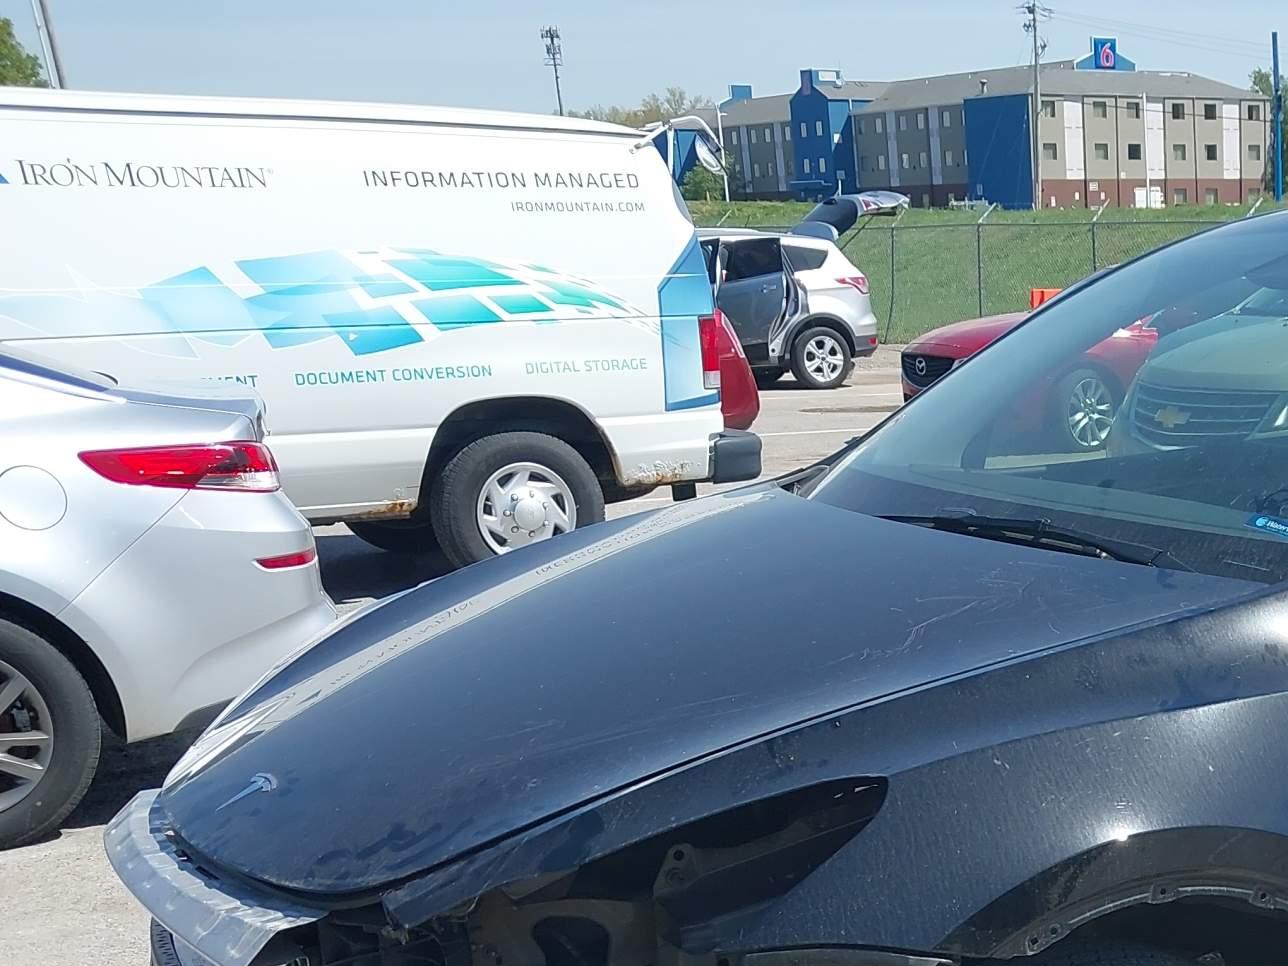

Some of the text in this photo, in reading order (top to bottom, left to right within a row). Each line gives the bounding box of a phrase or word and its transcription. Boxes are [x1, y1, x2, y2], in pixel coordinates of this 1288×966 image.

[1100, 42, 1115, 67] 6
[101, 161, 268, 189] MOUNTAIN
[363, 170, 640, 189] INFORMATION MANAGED
[511, 201, 645, 213] IRONMOUNTAIN.COM
[295, 364, 493, 387] DOCUMENT CONVERSION
[525, 358, 648, 375] DIGITAL STORAGE
